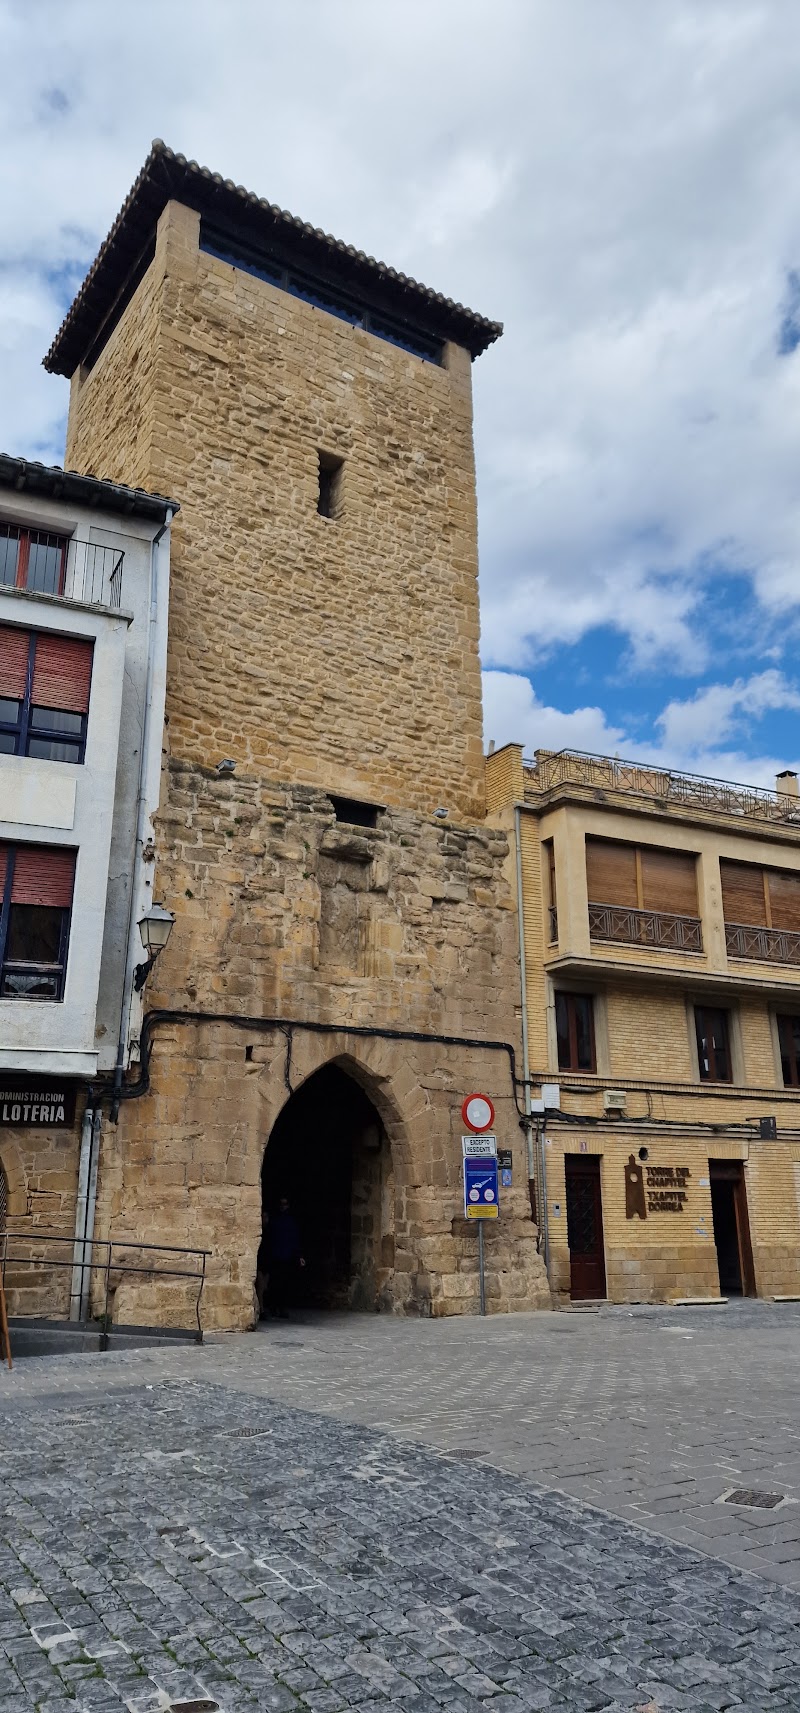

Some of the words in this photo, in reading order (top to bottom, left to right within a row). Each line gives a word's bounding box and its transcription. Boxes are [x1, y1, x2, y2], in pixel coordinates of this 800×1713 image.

[0, 1091, 65, 1102] DMINISTRACION
[2, 1104, 65, 1122] LOTERIA
[646, 1167, 674, 1177] TORRE
[676, 1168, 692, 1177] DEL
[647, 1178, 688, 1188] CHAPITEL
[647, 1192, 689, 1202] TXAPITEL
[648, 1202, 684, 1212] DORREA
